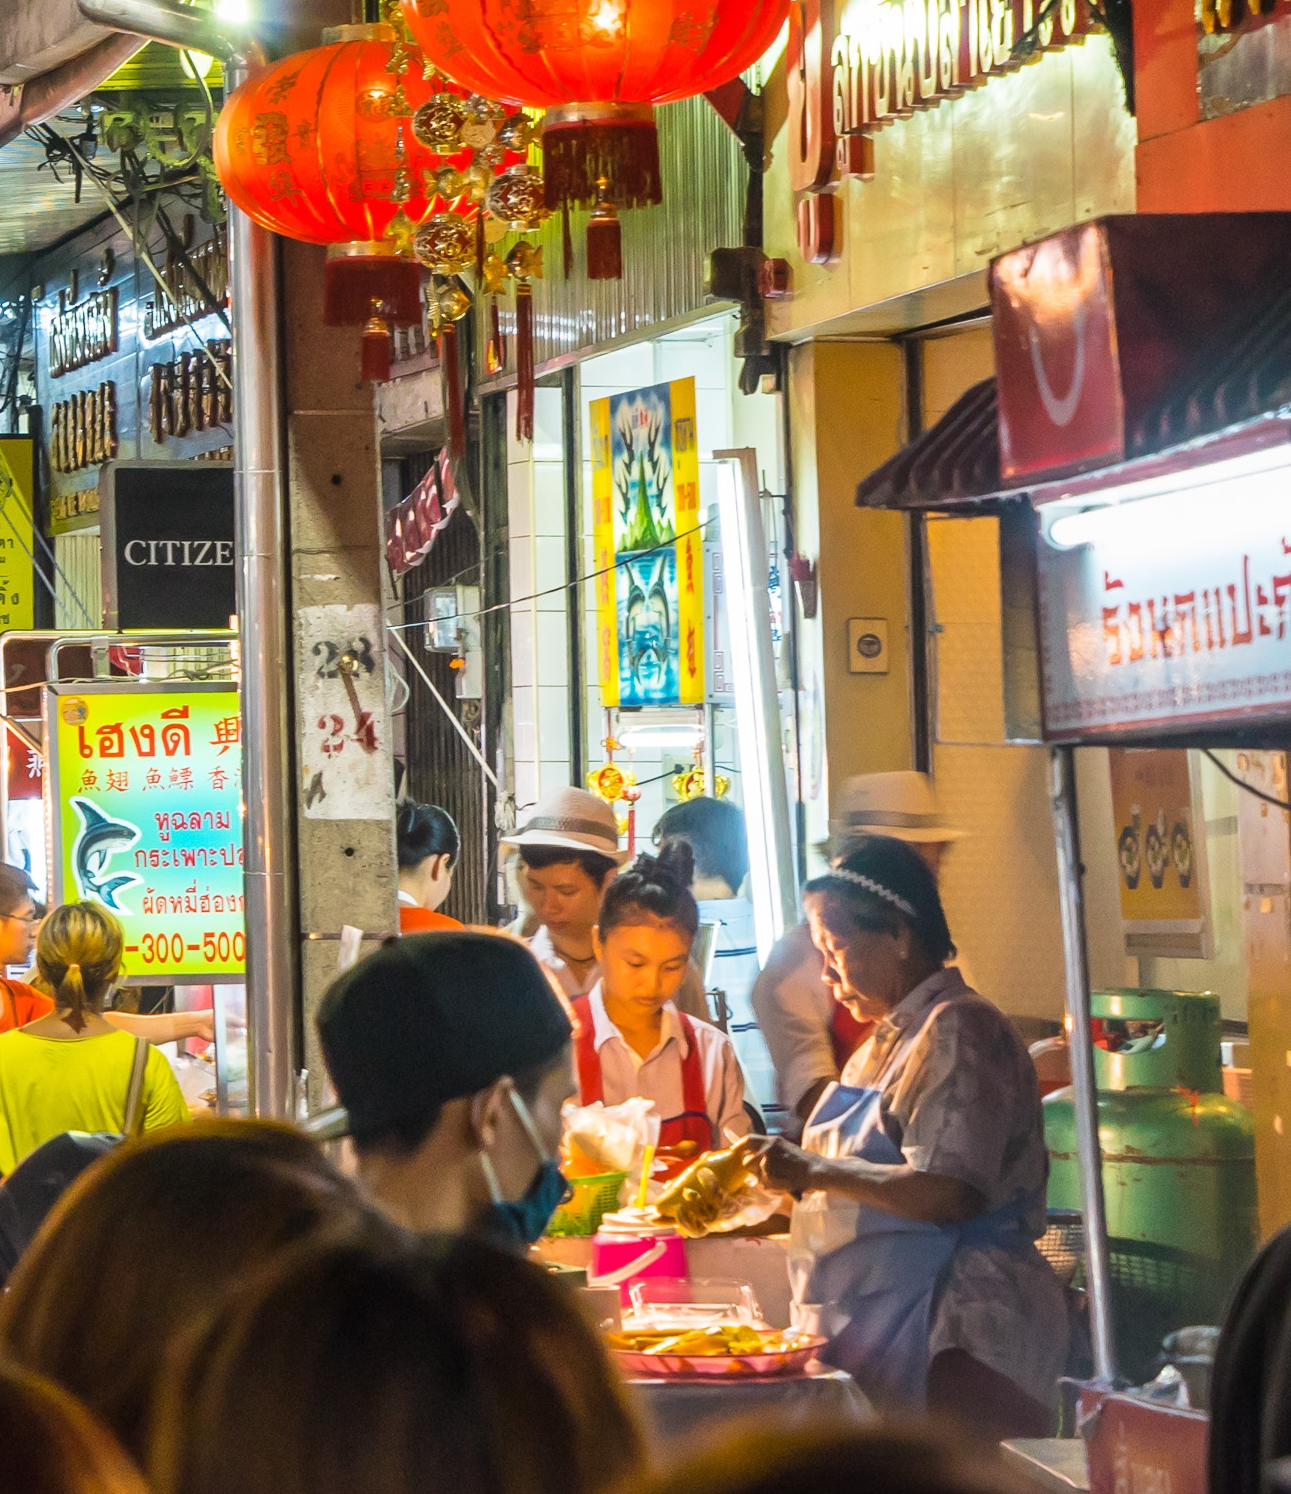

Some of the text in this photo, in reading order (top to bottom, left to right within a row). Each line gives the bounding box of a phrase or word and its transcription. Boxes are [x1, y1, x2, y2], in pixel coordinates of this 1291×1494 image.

[124, 538, 233, 567] CITIZE
[77, 704, 191, 759] เฮงดี
[77, 768, 130, 793] 魚翅
[154, 808, 231, 841] หูฉลาม
[142, 878, 243, 915] ผัดหมี่ฮ่อง
